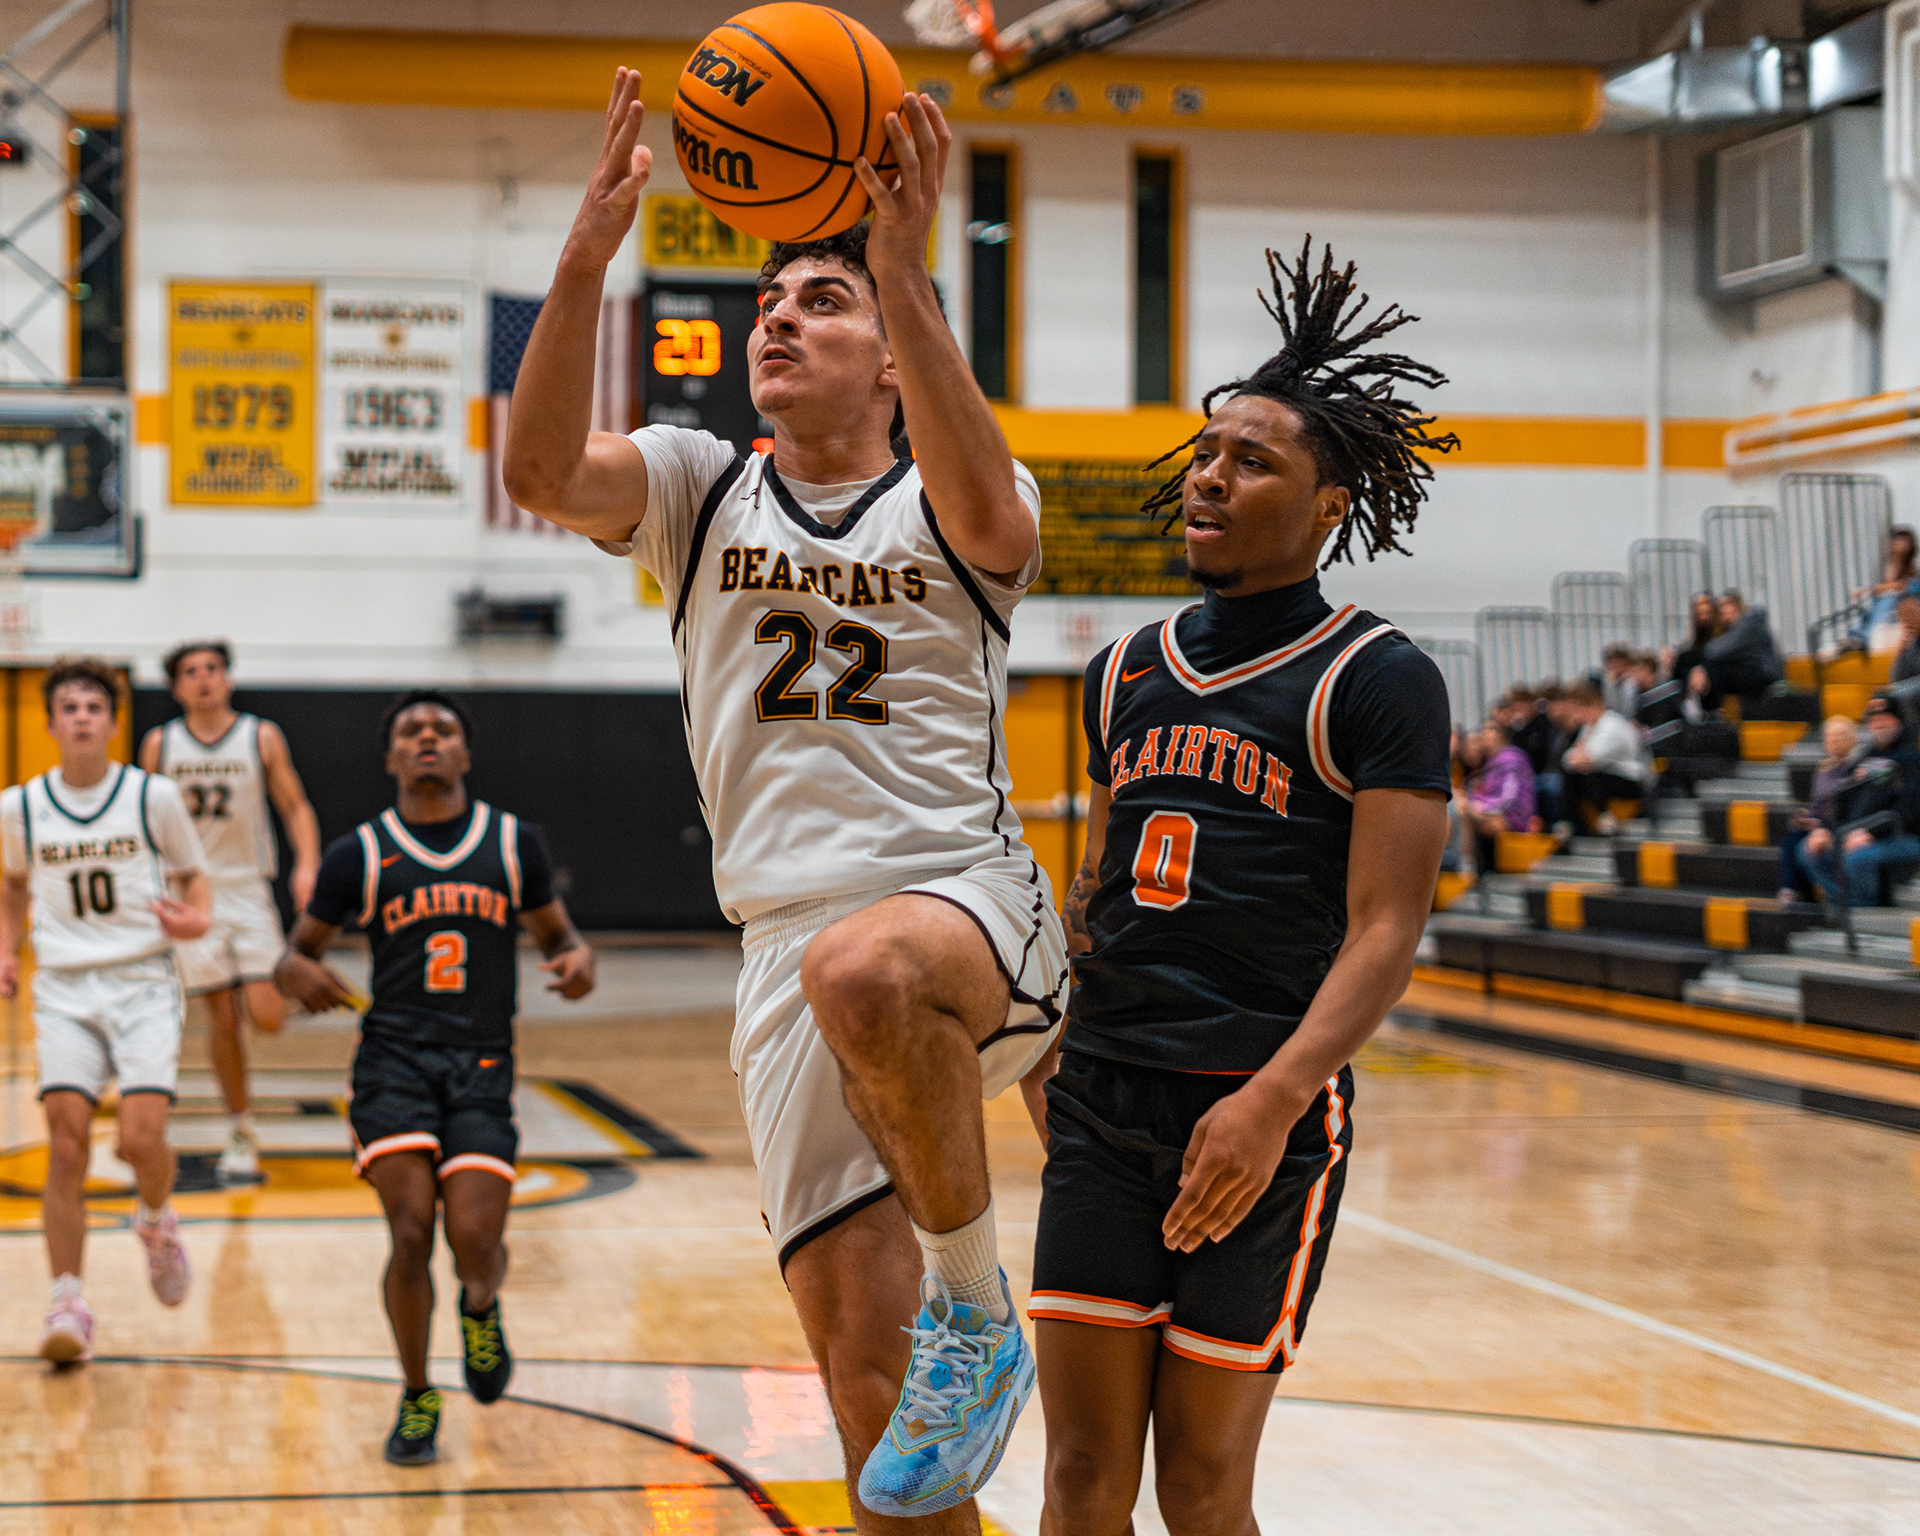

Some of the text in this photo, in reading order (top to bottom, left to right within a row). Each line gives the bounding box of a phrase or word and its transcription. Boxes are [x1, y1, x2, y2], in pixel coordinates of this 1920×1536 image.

[687, 44, 767, 108] NCAA
[672, 116, 759, 191] Wilso
[193, 384, 293, 431] 1979
[345, 385, 439, 432] 1963
[719, 547, 928, 608] BEARCATS
[754, 609, 889, 725] 22
[186, 784, 232, 820] 32
[1110, 724, 1293, 818] CLAIRTON
[1131, 809, 1199, 912] 0
[68, 867, 116, 919] 10
[382, 881, 509, 934] CLAIRTON
[424, 929, 468, 994] 2
